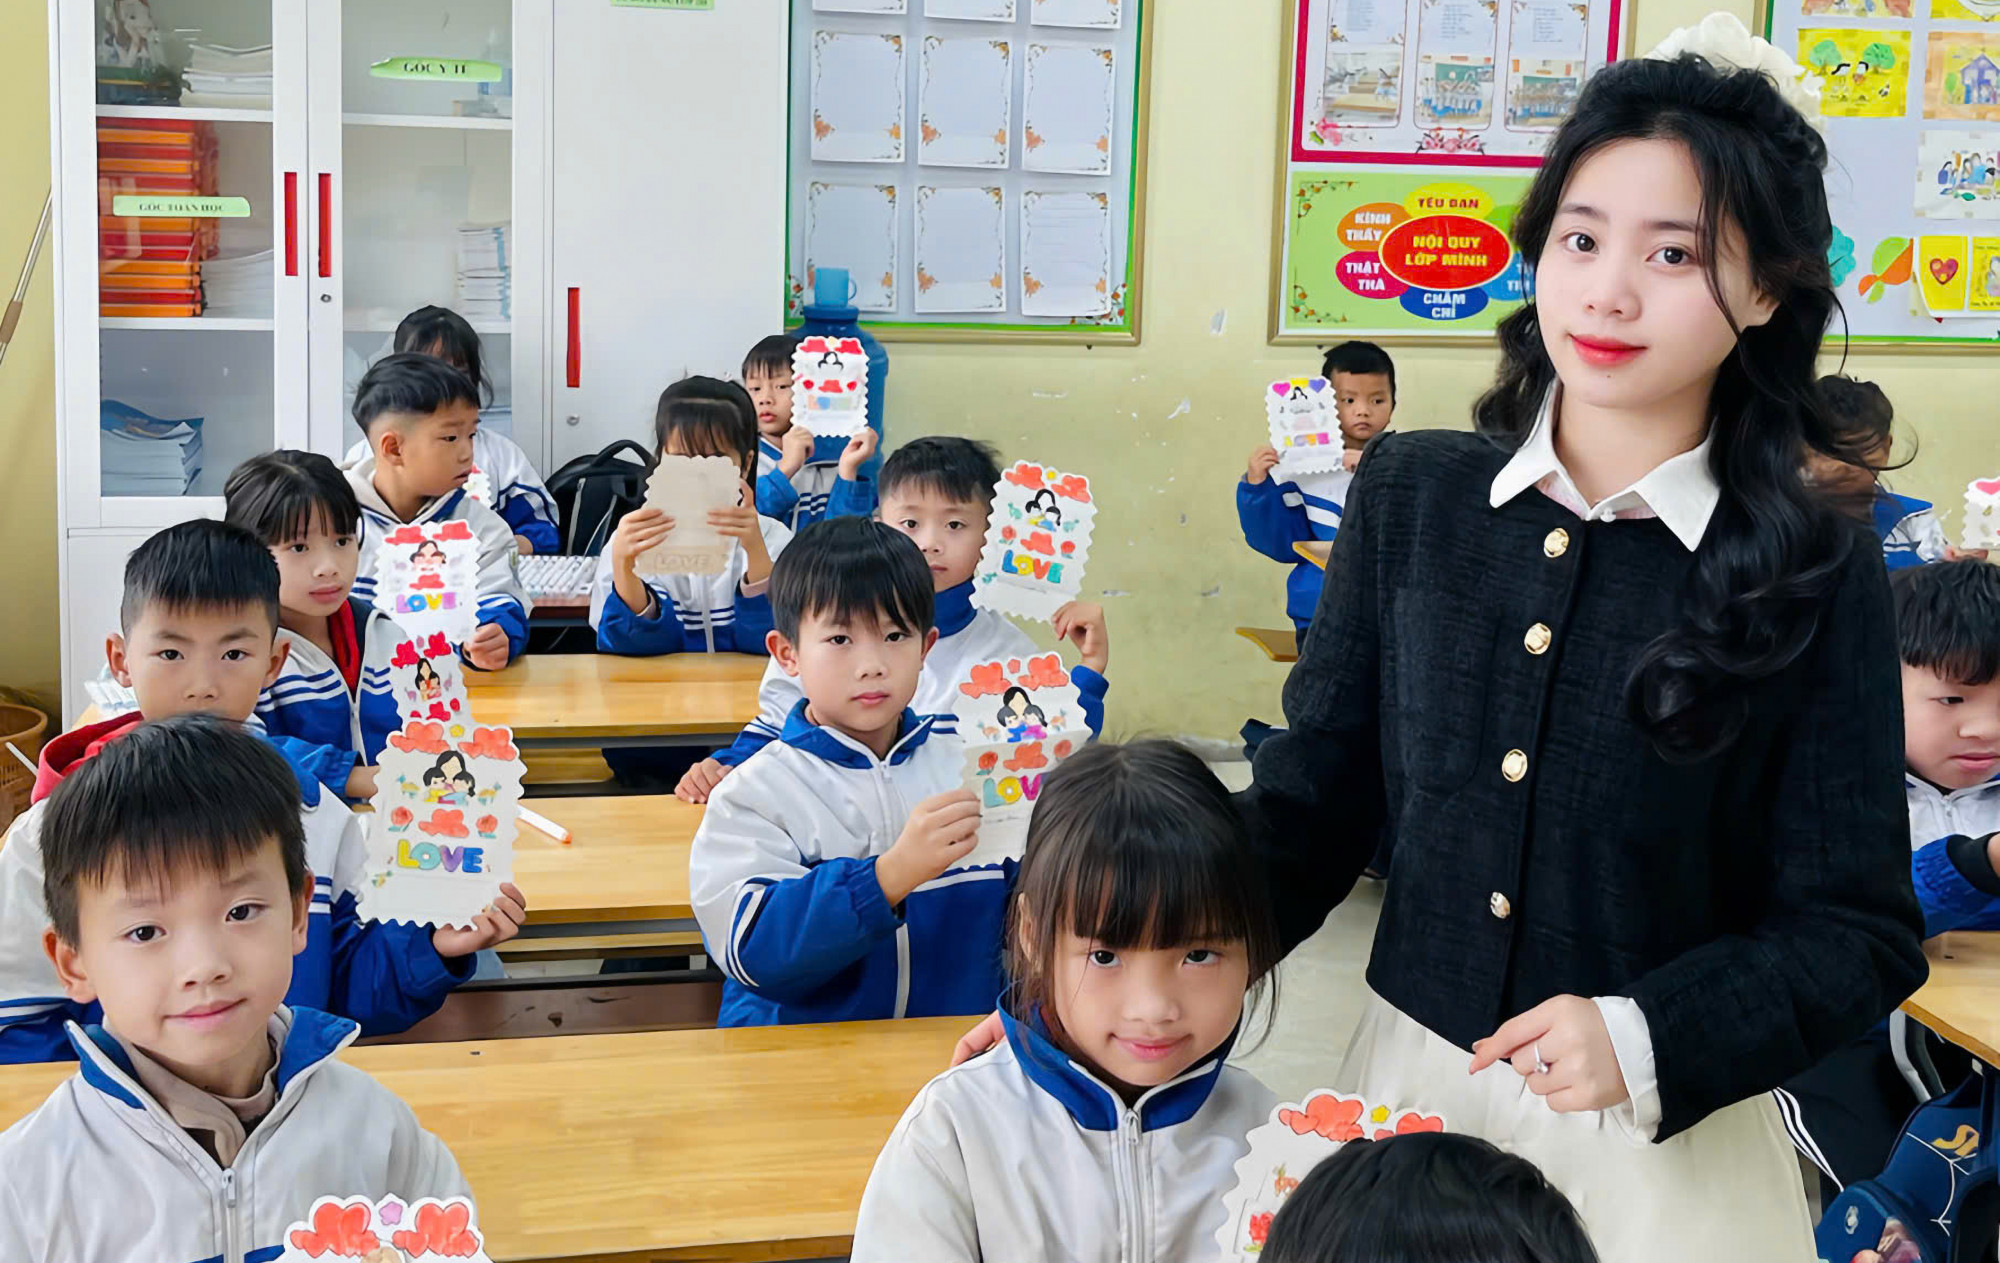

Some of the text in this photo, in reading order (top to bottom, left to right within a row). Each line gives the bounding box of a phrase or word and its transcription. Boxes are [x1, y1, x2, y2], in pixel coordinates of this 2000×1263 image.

[1447, 236, 1481, 249] QUY
[1001, 549, 1064, 584] LOVE
[396, 591, 457, 613] LOVE
[983, 772, 1045, 809] LOV
[397, 838, 484, 873] LOVE
